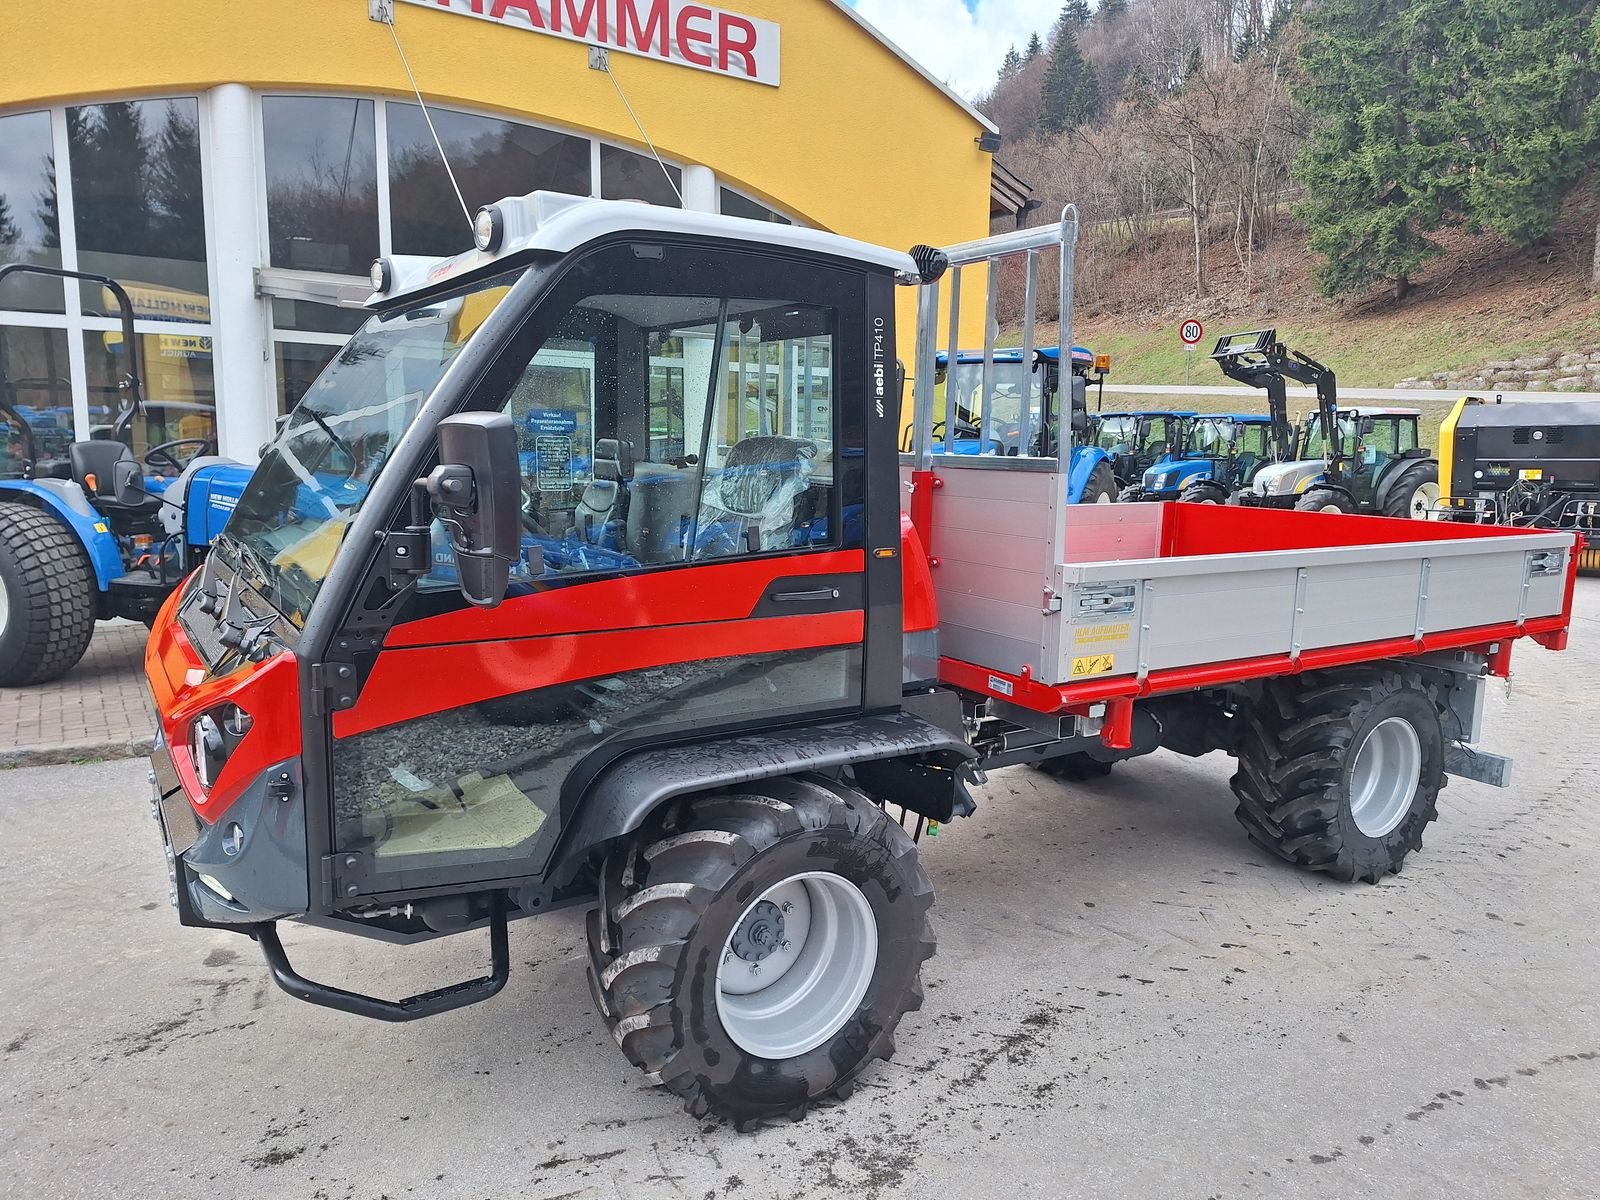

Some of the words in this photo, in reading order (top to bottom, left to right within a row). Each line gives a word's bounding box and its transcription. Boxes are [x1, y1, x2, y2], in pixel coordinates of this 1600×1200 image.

[438, 0, 758, 77] AMMER
[874, 317, 884, 360] TP410
[1185, 325, 1199, 338] 80
[874, 363, 884, 395] aebi
